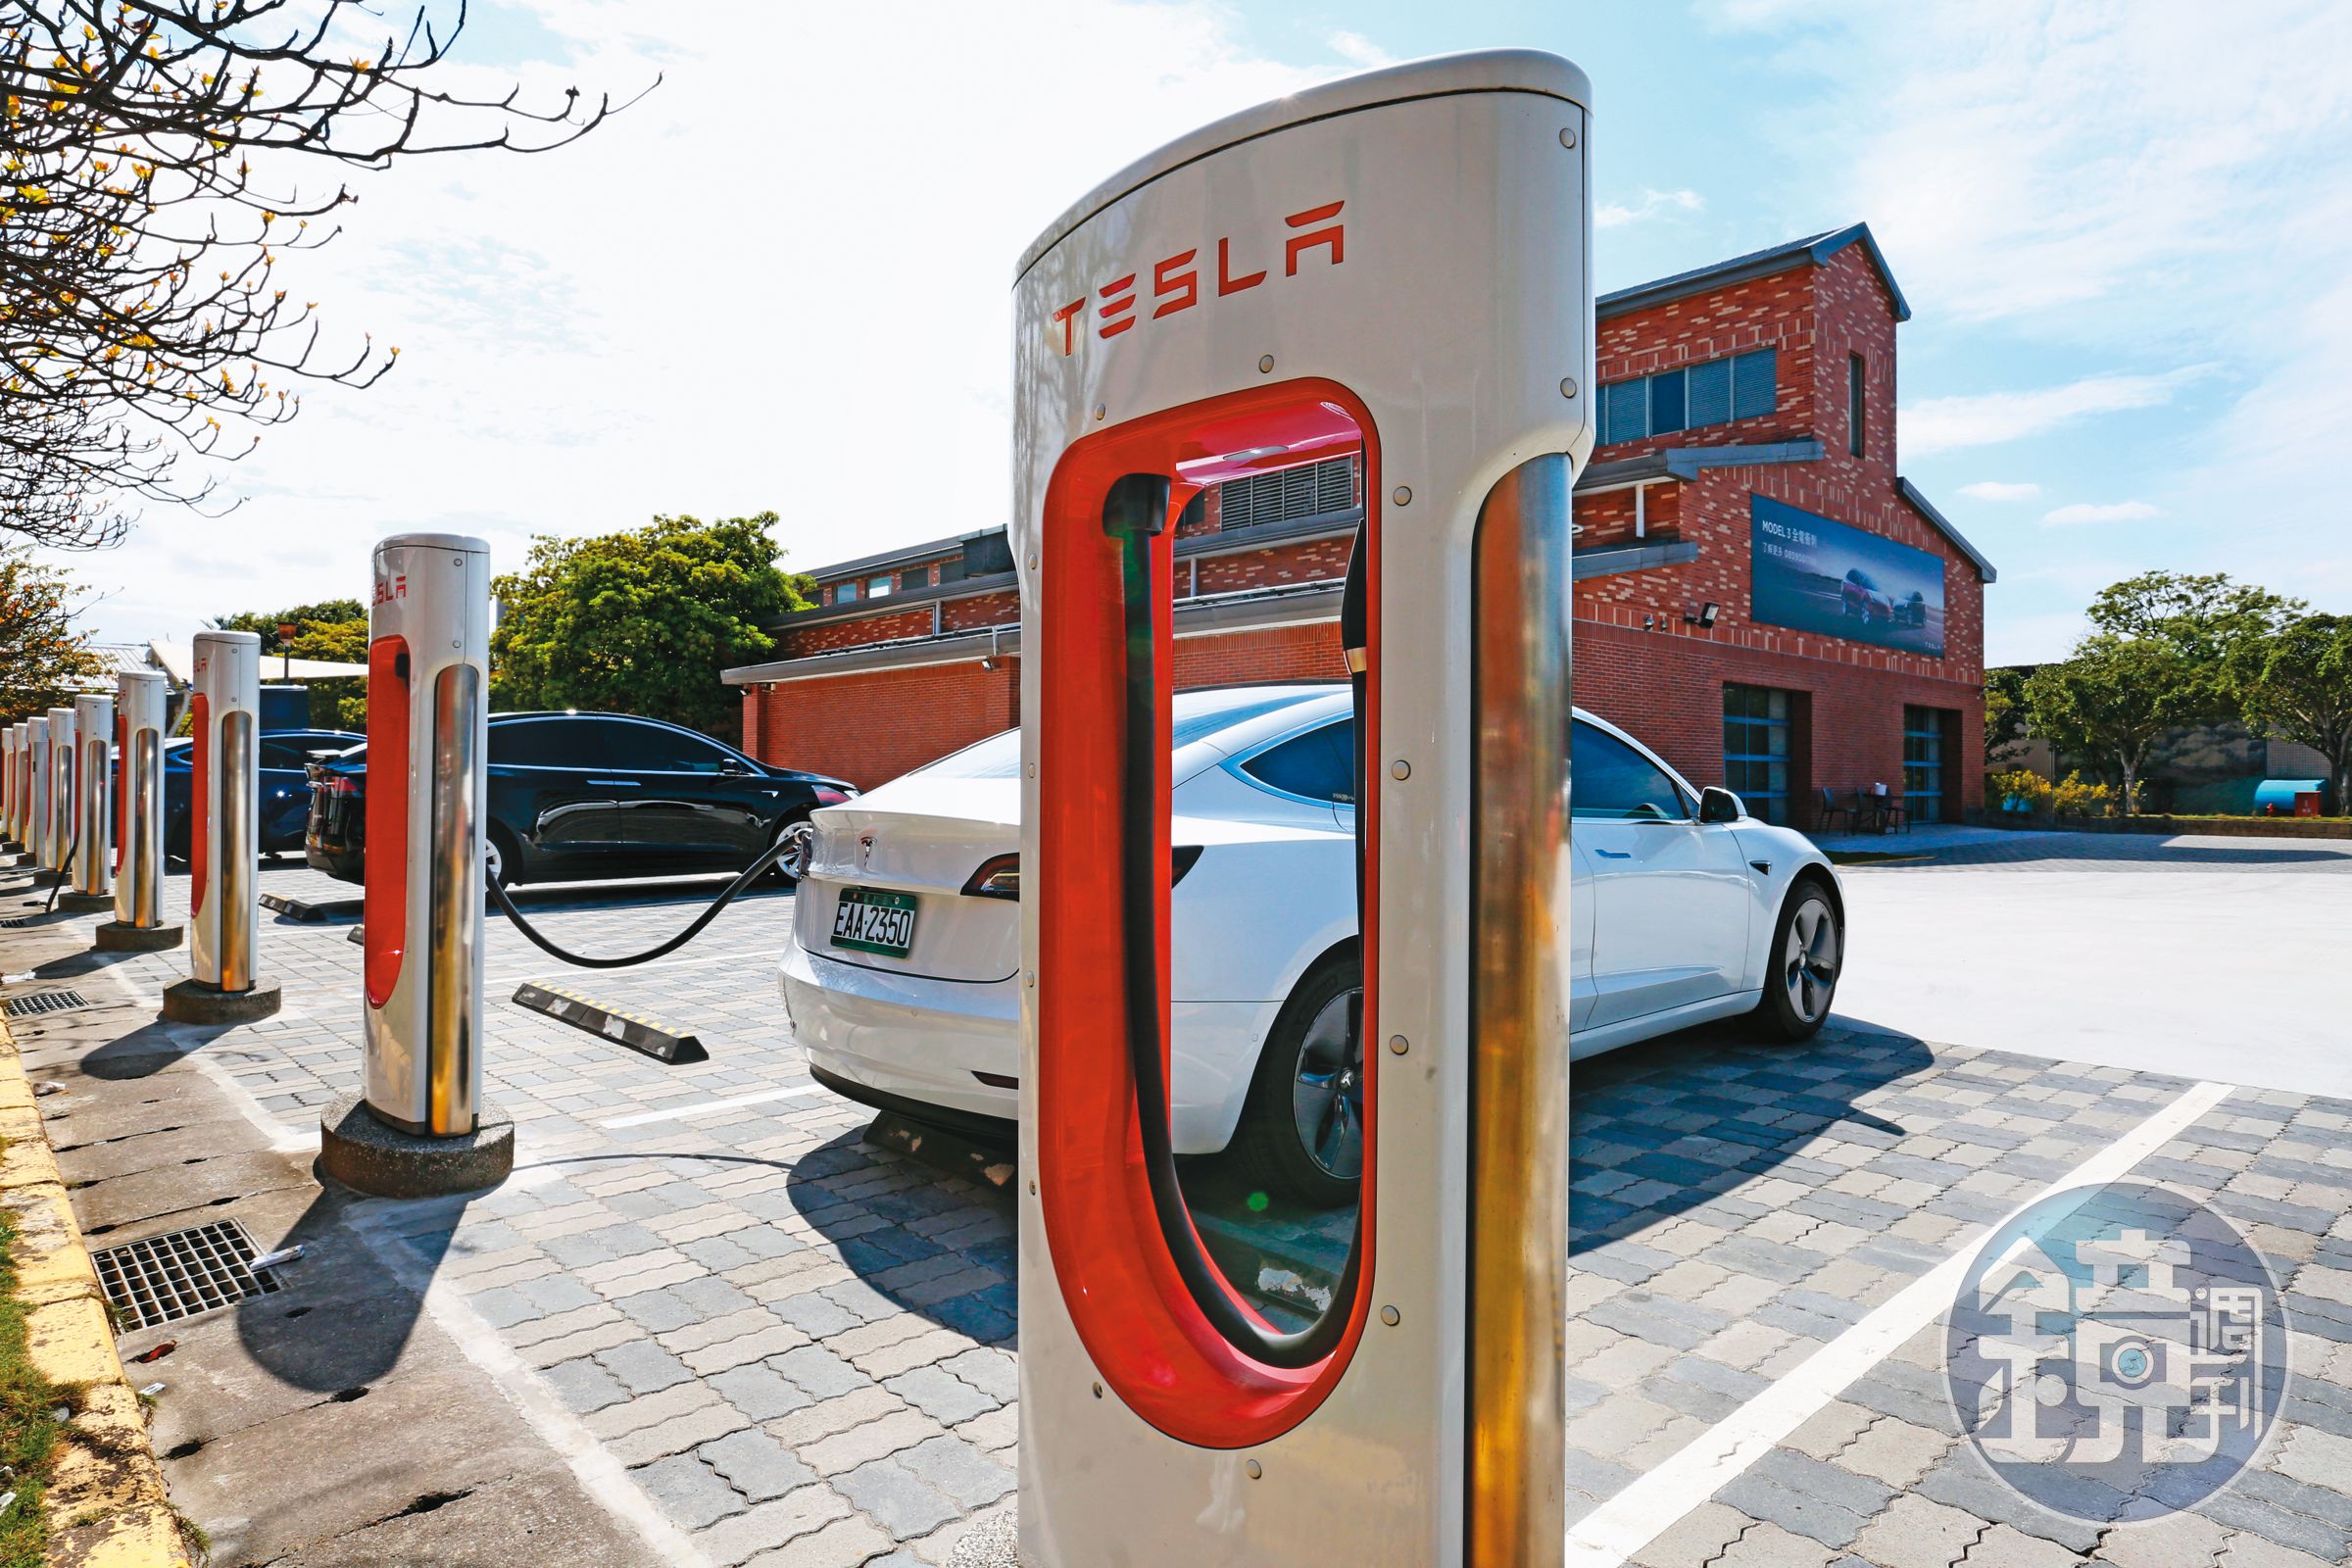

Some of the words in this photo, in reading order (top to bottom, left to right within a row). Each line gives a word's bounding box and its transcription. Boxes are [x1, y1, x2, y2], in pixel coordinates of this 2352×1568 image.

[1053, 200, 1345, 357] TESLA
[1762, 519, 1786, 538] MODEL
[1787, 527, 1791, 539] 3
